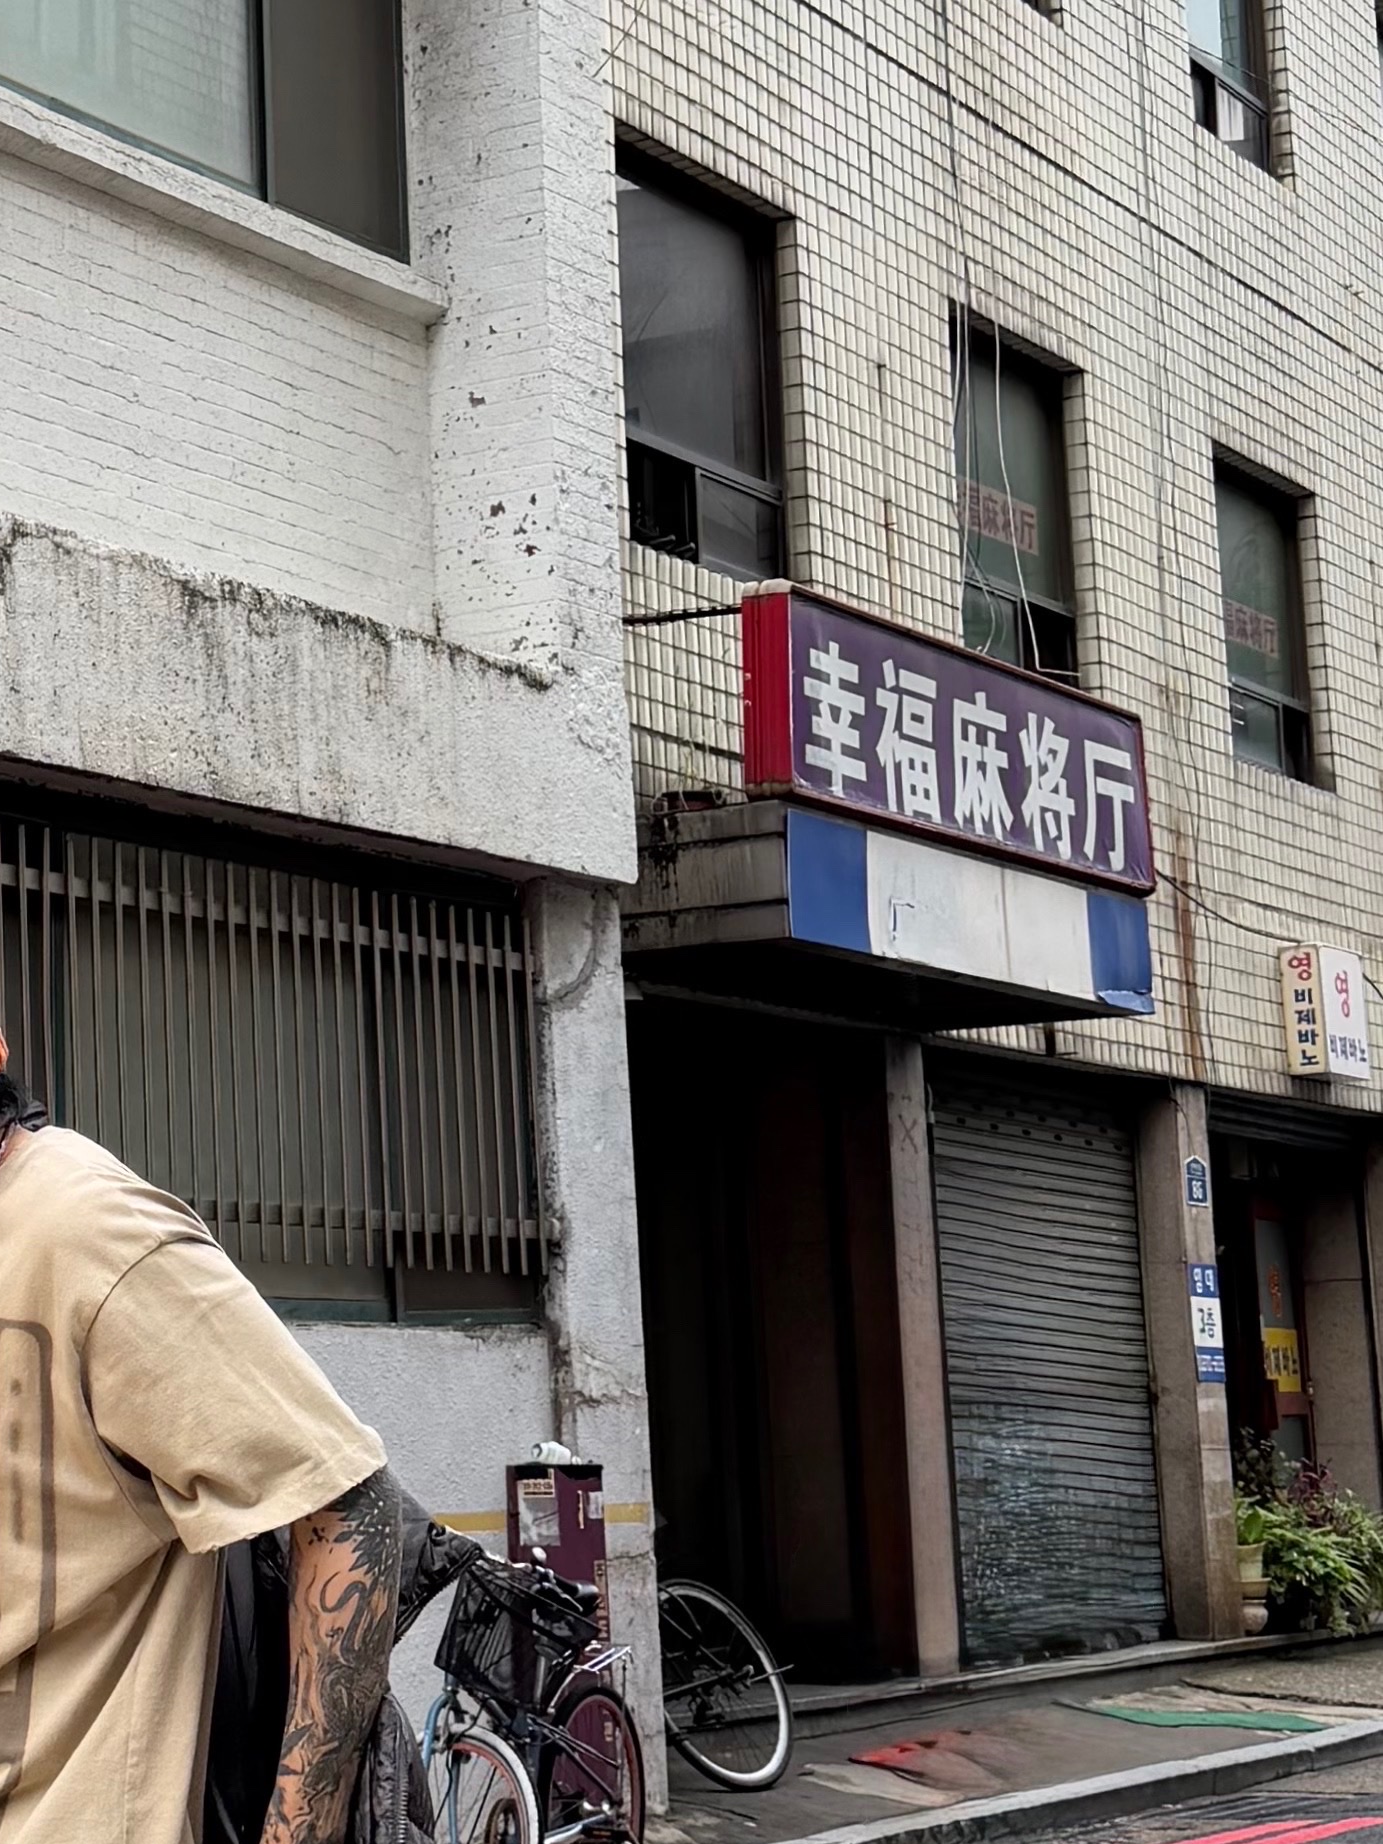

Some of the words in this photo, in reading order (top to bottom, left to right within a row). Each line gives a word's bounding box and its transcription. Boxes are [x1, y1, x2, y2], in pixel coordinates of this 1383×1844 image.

[803, 641, 1136, 872] 幸福麻将厅
[1293, 987, 1320, 1067] 비제바노
